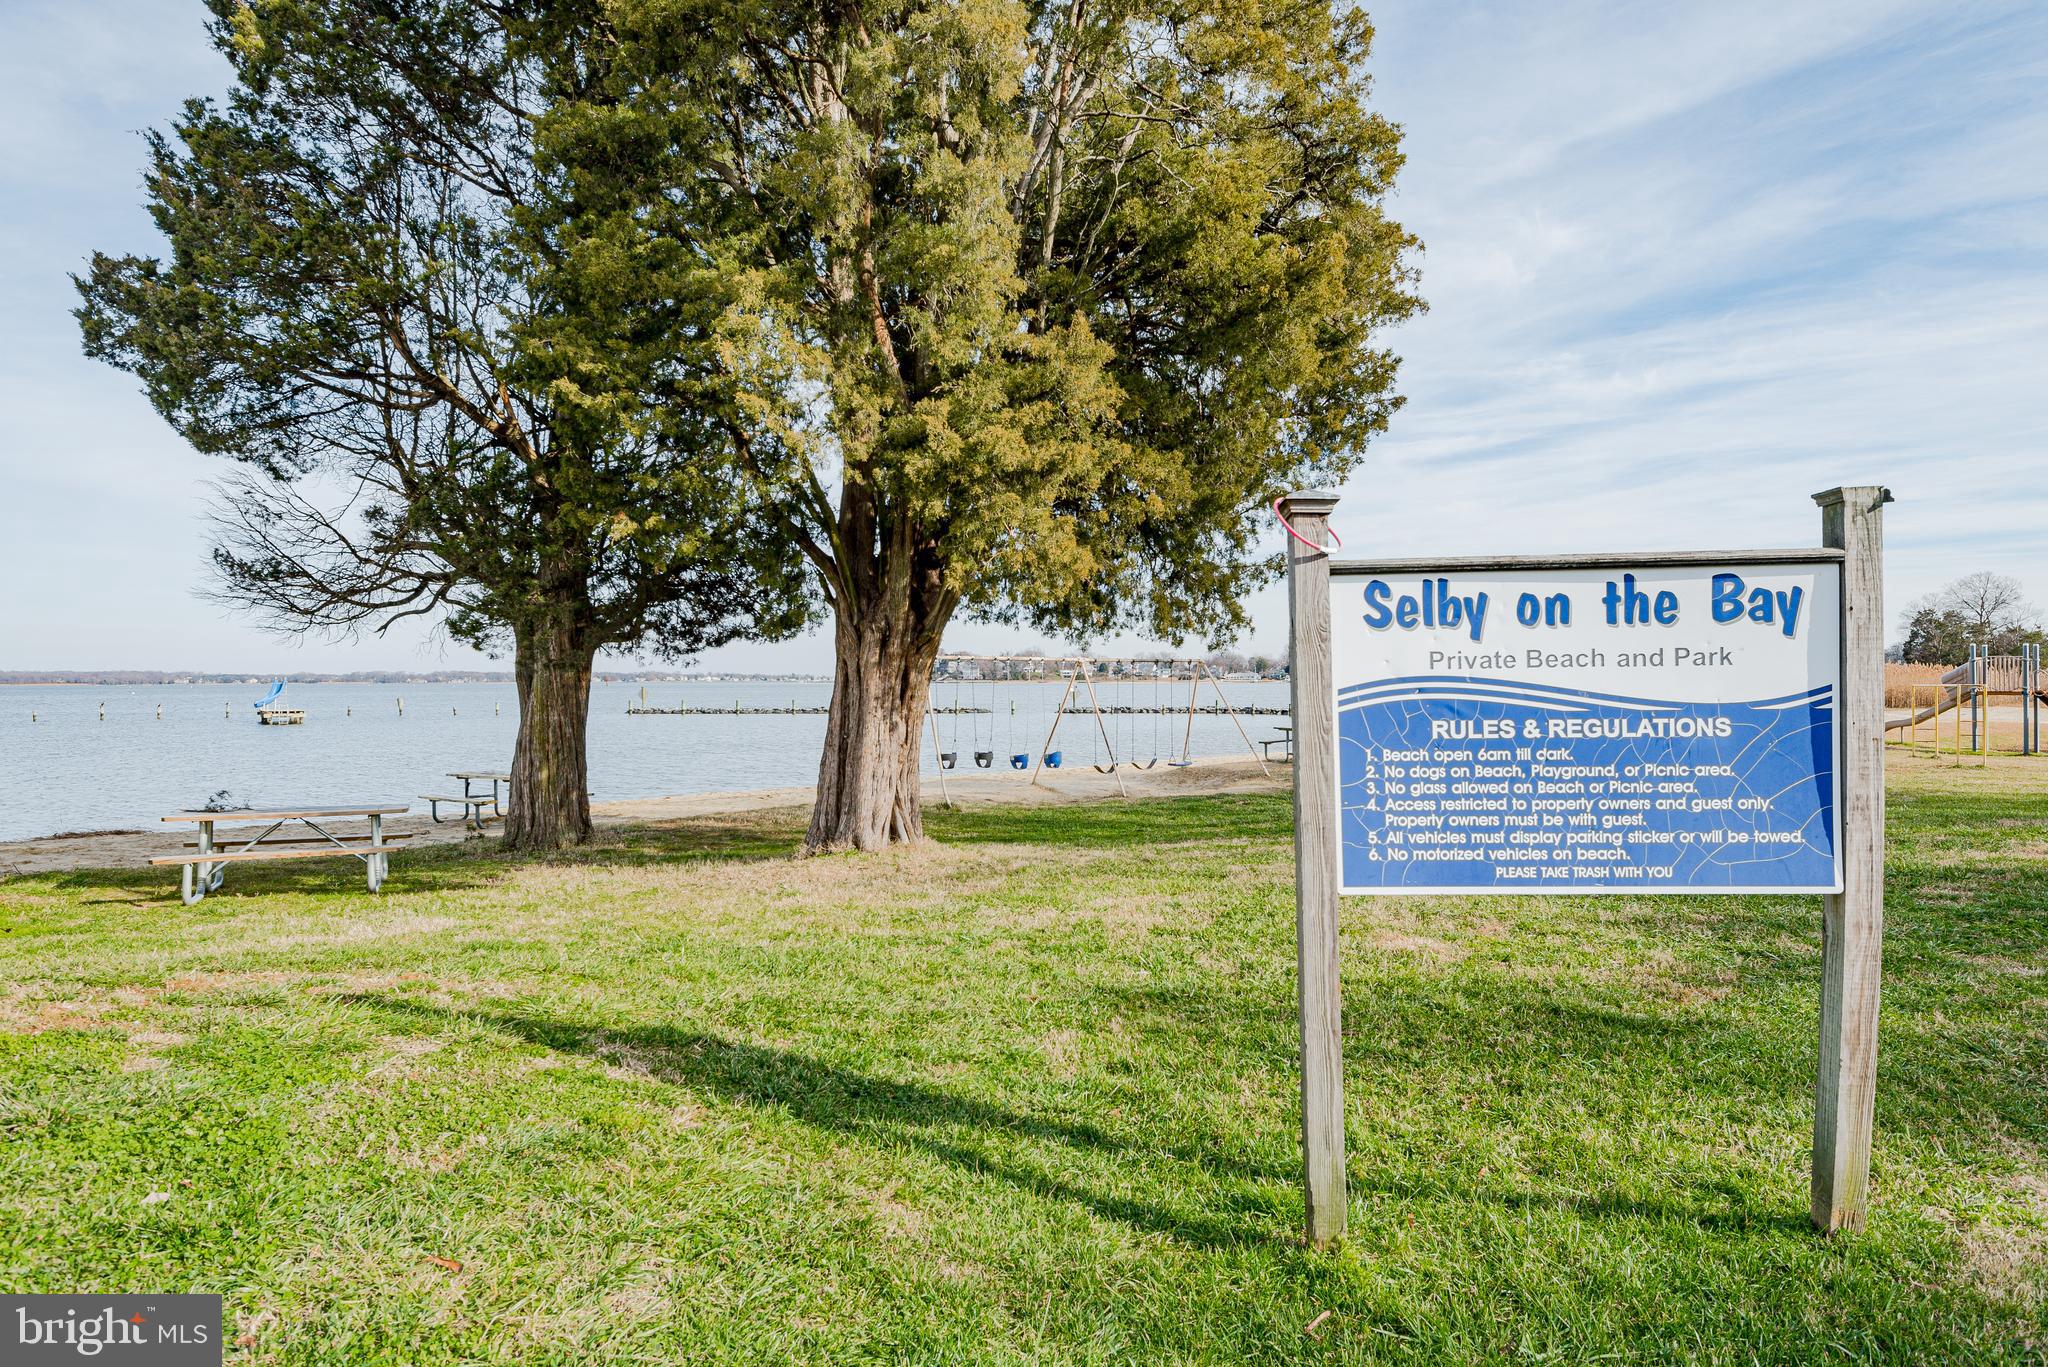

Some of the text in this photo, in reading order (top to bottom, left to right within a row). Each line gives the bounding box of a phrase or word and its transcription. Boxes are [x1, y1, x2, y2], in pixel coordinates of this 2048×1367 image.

[1362, 573, 1803, 642] Selby on the Bay
[1429, 646, 1733, 670] Private Beach and Park
[1432, 718, 1732, 739] RULES & REGULATIONS
[1383, 749, 1429, 762] Beach
[1434, 751, 1472, 765] open
[1477, 748, 1511, 761] 6am
[1516, 748, 1531, 761] till
[1536, 748, 1574, 761] dark.
[1366, 764, 1735, 781] 2. No dogs on Beach, Playground, or Picnic area.
[1367, 781, 1698, 798] 3. No glass allowed on Beach or Picnic area.
[1367, 797, 1774, 814] 4. Access restricted to property owners and guest only.
[1386, 813, 1647, 831] Property owners must be with guest.
[1368, 829, 1805, 847] 5. All vehicles must display parking sticker or will be towed.
[1369, 847, 1631, 861] 6. No motorized vehicles on beach.
[1496, 866, 1673, 878] PLEASE TAKE TRASH WITH YOU
